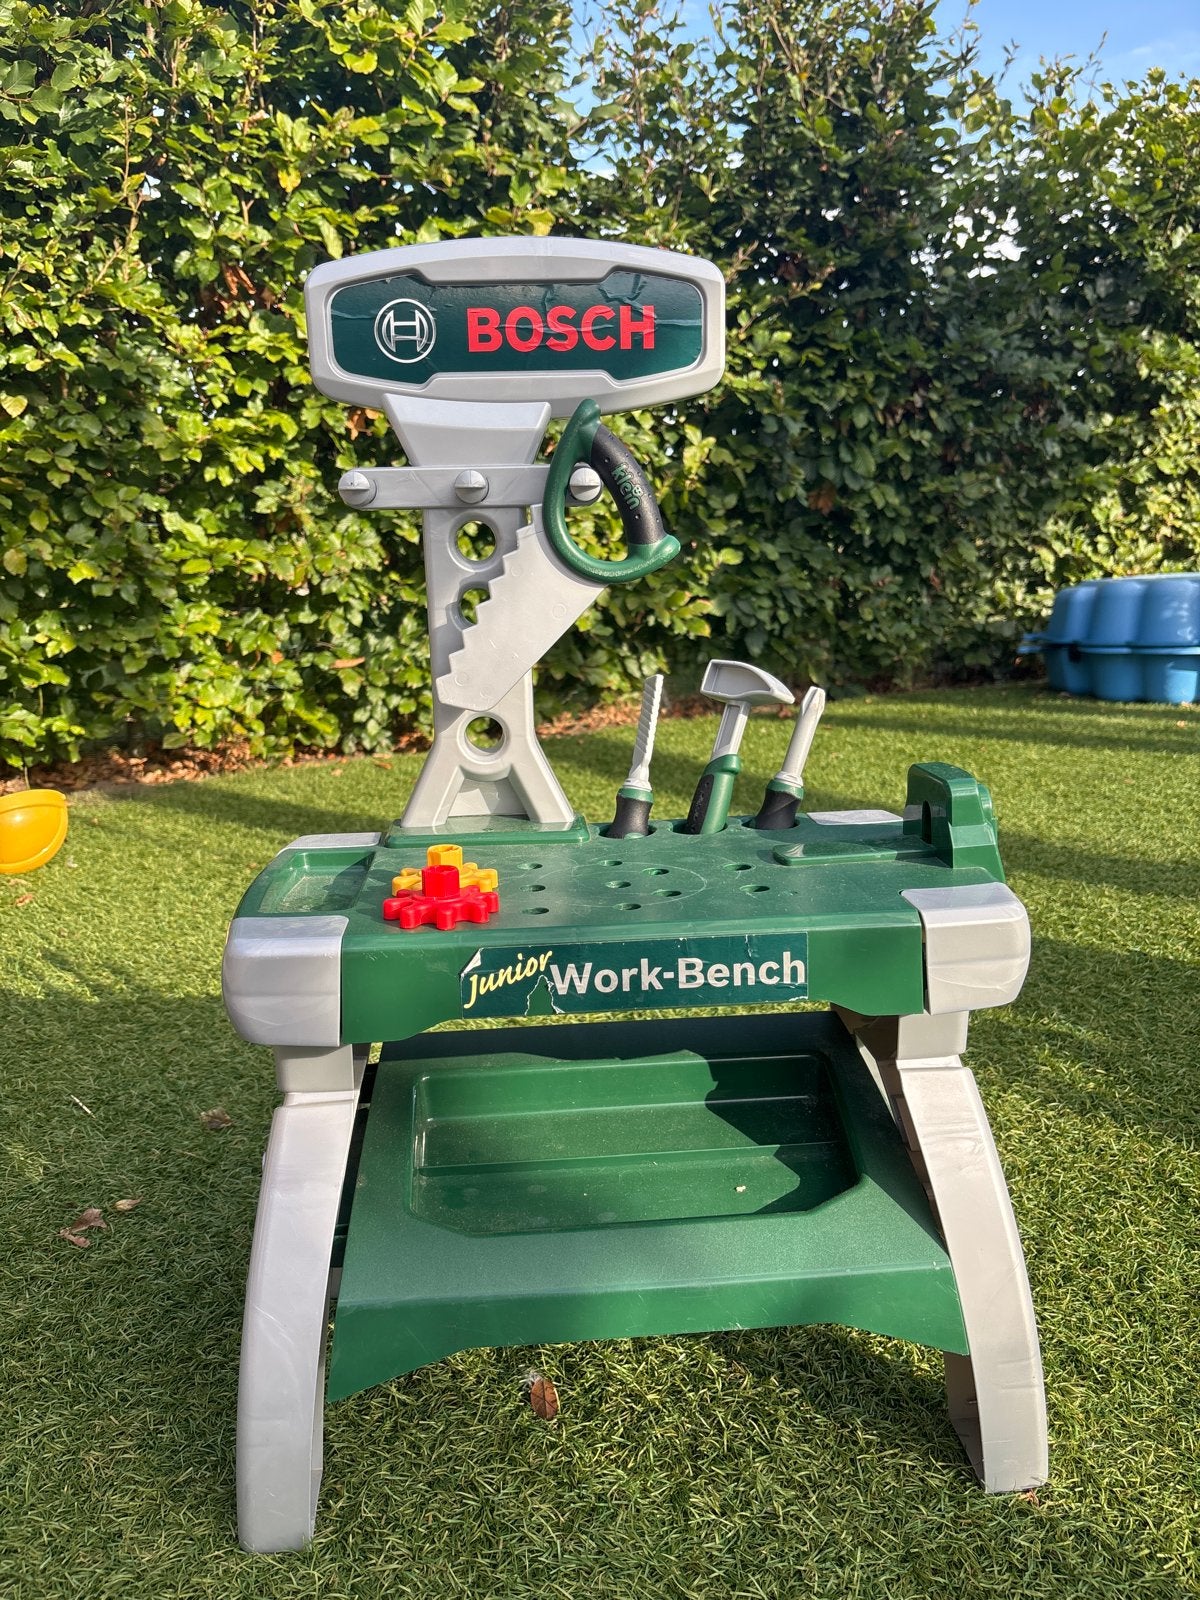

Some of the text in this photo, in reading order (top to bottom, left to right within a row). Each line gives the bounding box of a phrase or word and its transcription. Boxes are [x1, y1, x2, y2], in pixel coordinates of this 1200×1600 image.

[467, 305, 656, 353] BOSCH
[464, 950, 806, 1009] Junior Work-Bench
